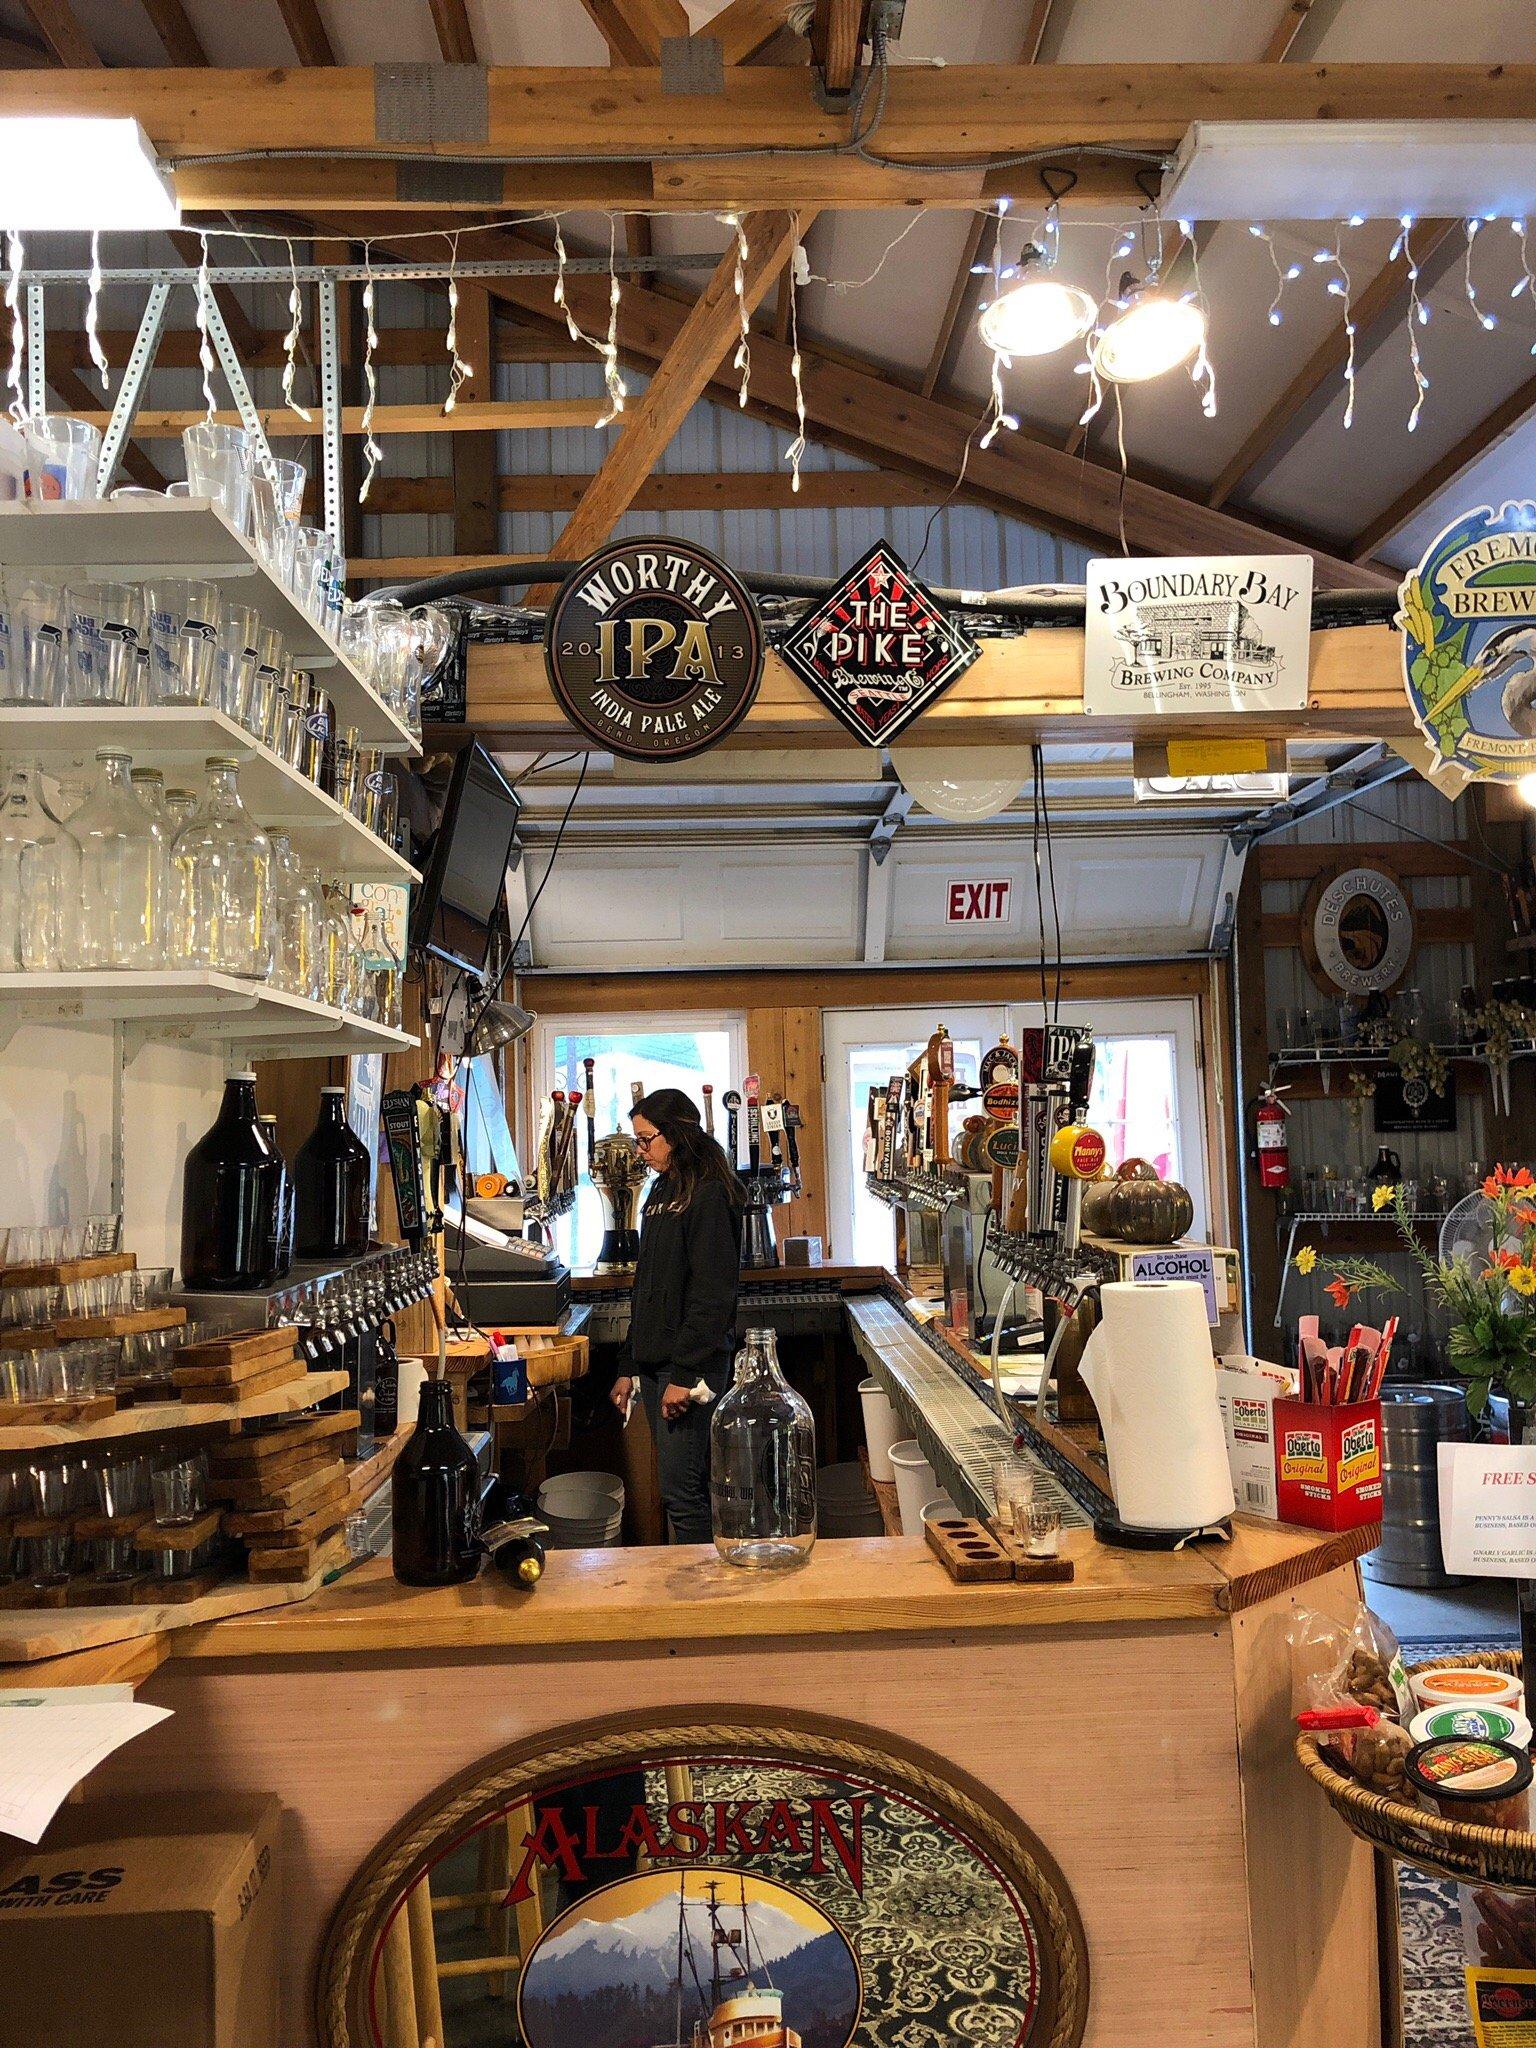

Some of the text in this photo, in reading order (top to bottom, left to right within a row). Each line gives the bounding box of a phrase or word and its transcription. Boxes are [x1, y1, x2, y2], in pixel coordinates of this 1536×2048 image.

[1449, 536, 1536, 582] FREM
[576, 554, 738, 620] WORTHY
[1100, 570, 1299, 614] BOUNDARY BAY
[850, 601, 909, 629] THE
[562, 642, 591, 656] 20
[595, 618, 724, 685] IPA
[717, 645, 745, 659] 13
[831, 633, 922, 664] PIKE
[832, 667, 906, 691] Brewing
[1121, 663, 1274, 686] BREWING COMPANY
[1195, 682, 1211, 690] 1995
[850, 688, 908, 701] SEATTLE
[589, 687, 722, 734] INDIA PALE ALE
[653, 723, 711, 747] OREGON
[949, 881, 1009, 920] EXIT
[1322, 876, 1403, 926] DESCHUTES
[1335, 958, 1397, 988] BREWERY
[389, 1120, 409, 1130] STOUT
[750, 1108, 759, 1144] SCHILLING
[883, 1129, 892, 1175] BONEYARD
[1074, 1146, 1103, 1157] Manny's
[1135, 1259, 1211, 1277] ALCOHOL
[1238, 1406, 1266, 1418] Oberto
[1287, 1439, 1321, 1453] Oberto
[1343, 1431, 1374, 1454] Oberto
[1283, 1462, 1325, 1476] Original
[1340, 1454, 1377, 1483] Original
[1481, 1472, 1524, 1486] FREE
[1300, 1483, 1331, 1495] SMOKED
[1304, 1490, 1331, 1501] STICKS
[1355, 1483, 1382, 1495] SMOKED
[1359, 1490, 1382, 1501] STICKS
[500, 1799, 869, 1909] ALASKAN
[54, 1890, 111, 1907] CARE
